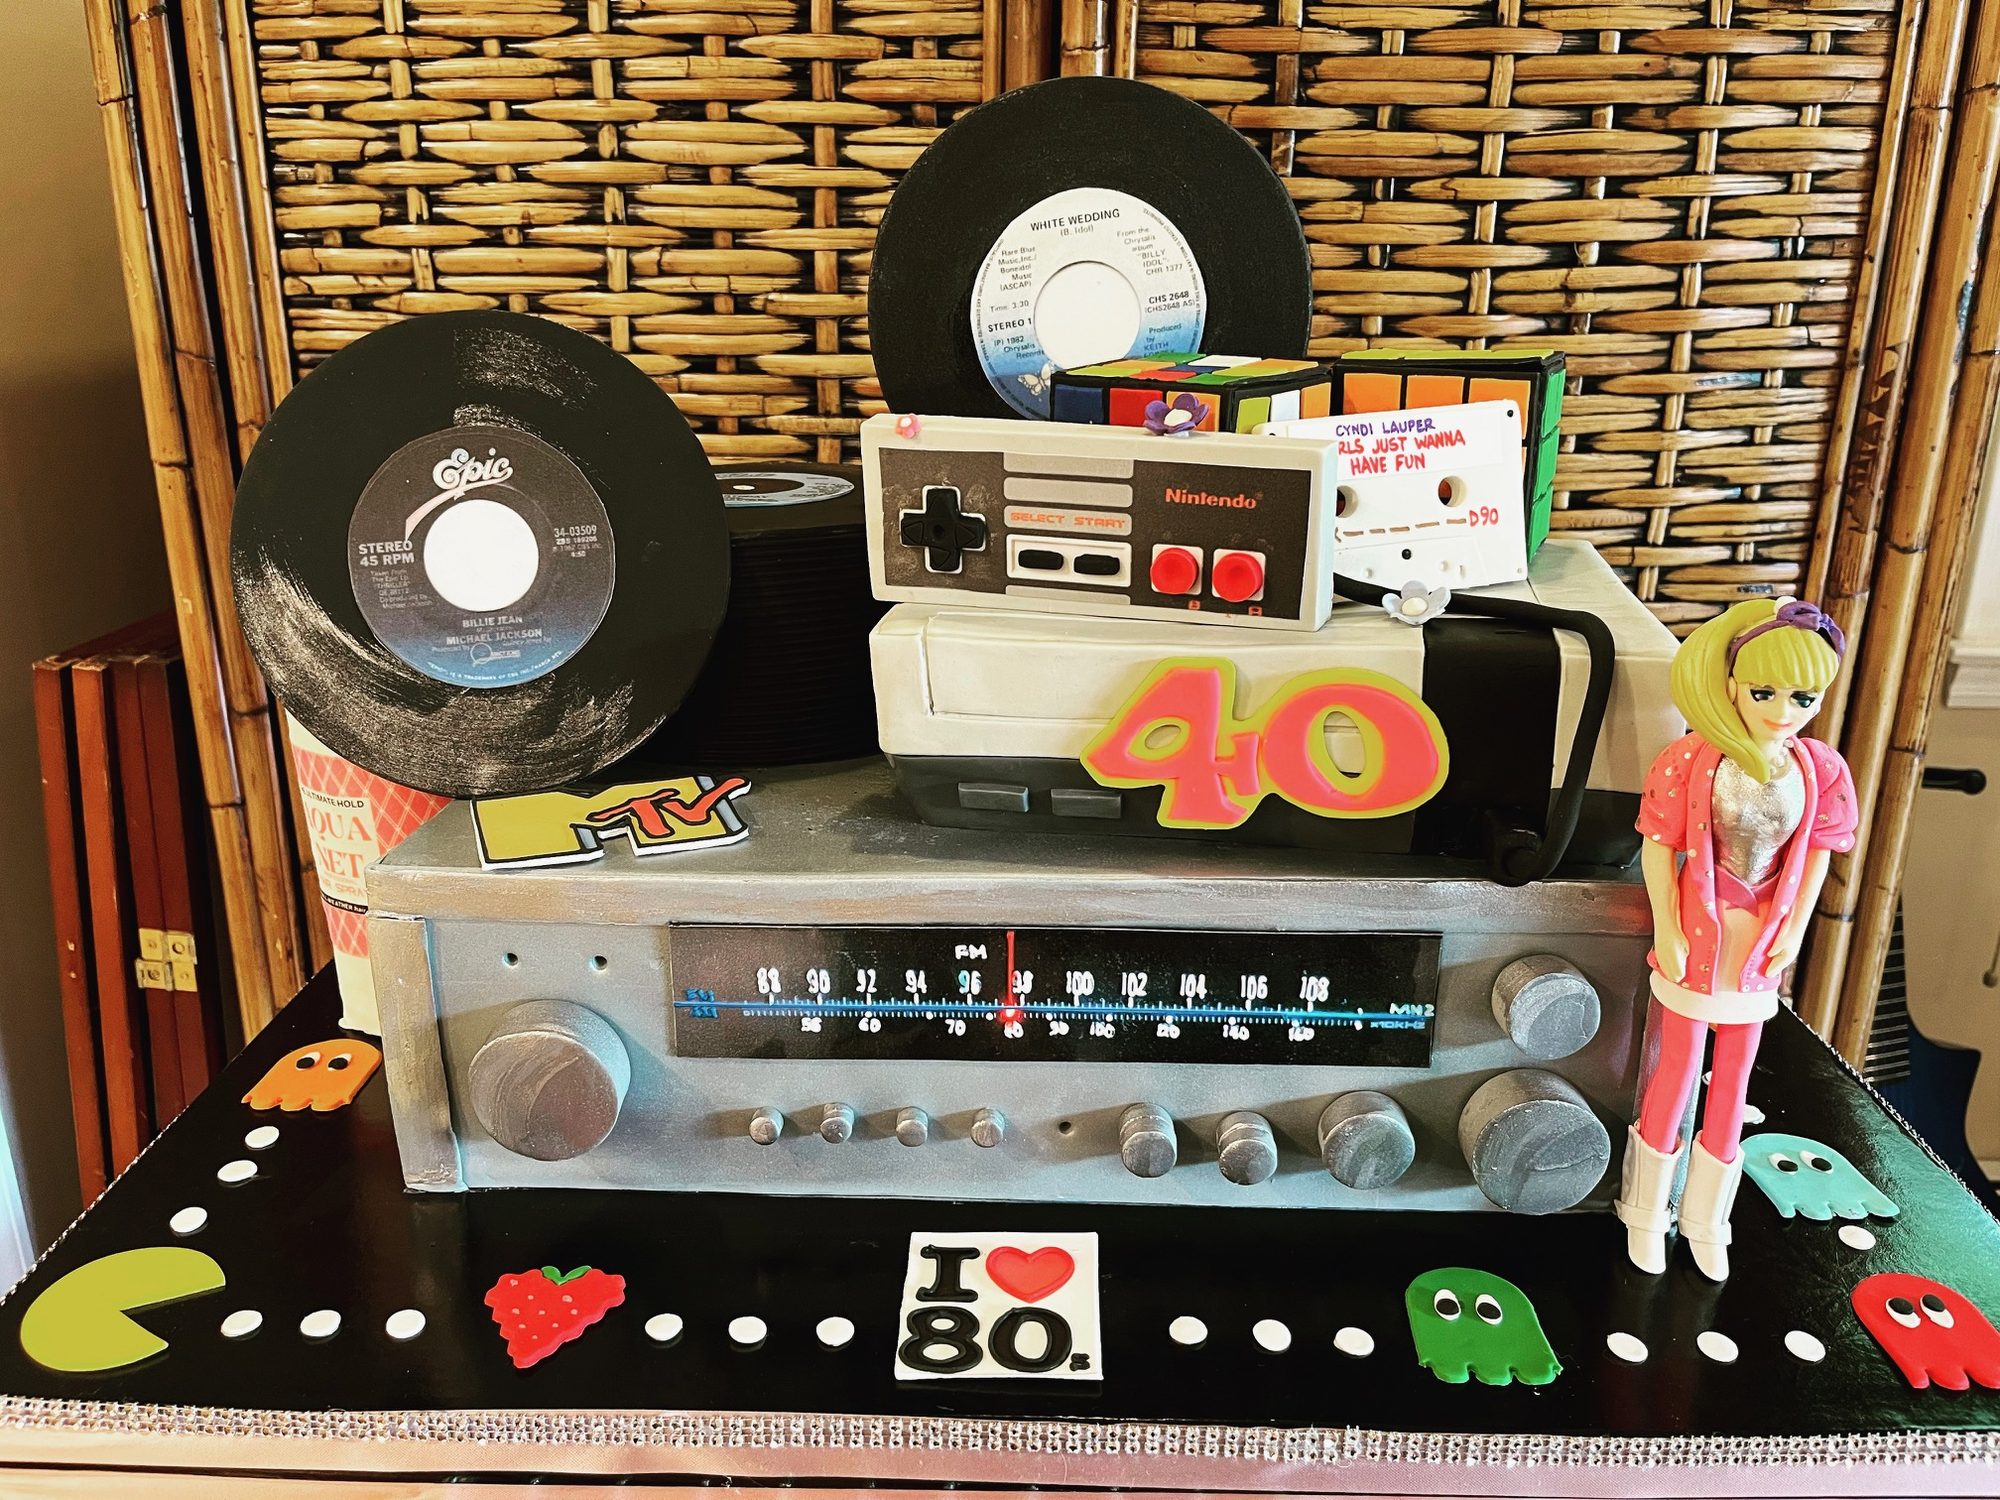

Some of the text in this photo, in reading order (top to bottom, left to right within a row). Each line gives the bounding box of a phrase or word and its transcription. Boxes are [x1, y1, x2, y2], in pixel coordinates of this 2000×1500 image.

[1030, 208, 1120, 231] WHITE WEDDING
[1074, 224, 1094, 235] Idol)
[1117, 230, 1136, 238] From
[1124, 235, 1156, 245] Chrysalis
[1012, 273, 1032, 281] Music
[1000, 280, 1031, 291] (ASCAP)
[1149, 290, 1189, 304] CHS 2648
[1145, 303, 1180, 313] (CHS2648
[988, 317, 1032, 333] STEREO 1
[1149, 323, 1182, 334] Produced
[1003, 342, 1036, 353] Chrysalis
[1007, 336, 1024, 345] 1982
[1143, 341, 1169, 352] KEITH
[1146, 337, 1155, 345] by
[1335, 417, 1436, 437] CYNDI LAUPER
[1338, 429, 1466, 456] RLS JUST WANNA
[1350, 453, 1426, 476] HAVE FUN
[432, 447, 514, 500] Epic
[1165, 488, 1257, 510] Nintendo
[1011, 511, 1126, 529] SELECT START
[554, 524, 597, 538] 34-03509
[358, 540, 413, 555] STEREO
[360, 552, 415, 567] 45 RPM
[462, 616, 523, 628] BILLIE JEAN
[446, 633, 491, 645] MICHAEL
[495, 628, 542, 641] JACKSON
[1082, 658, 1447, 828] 40
[337, 800, 364, 808] HOLD
[471, 777, 752, 868] MTV
[955, 944, 987, 960] FM
[757, 967, 1330, 1002] 88 90 92 94 96 98 100 102 104 106 108
[858, 1017, 881, 1033] 60
[945, 1019, 966, 1036] 70
[916, 1244, 980, 1302] I
